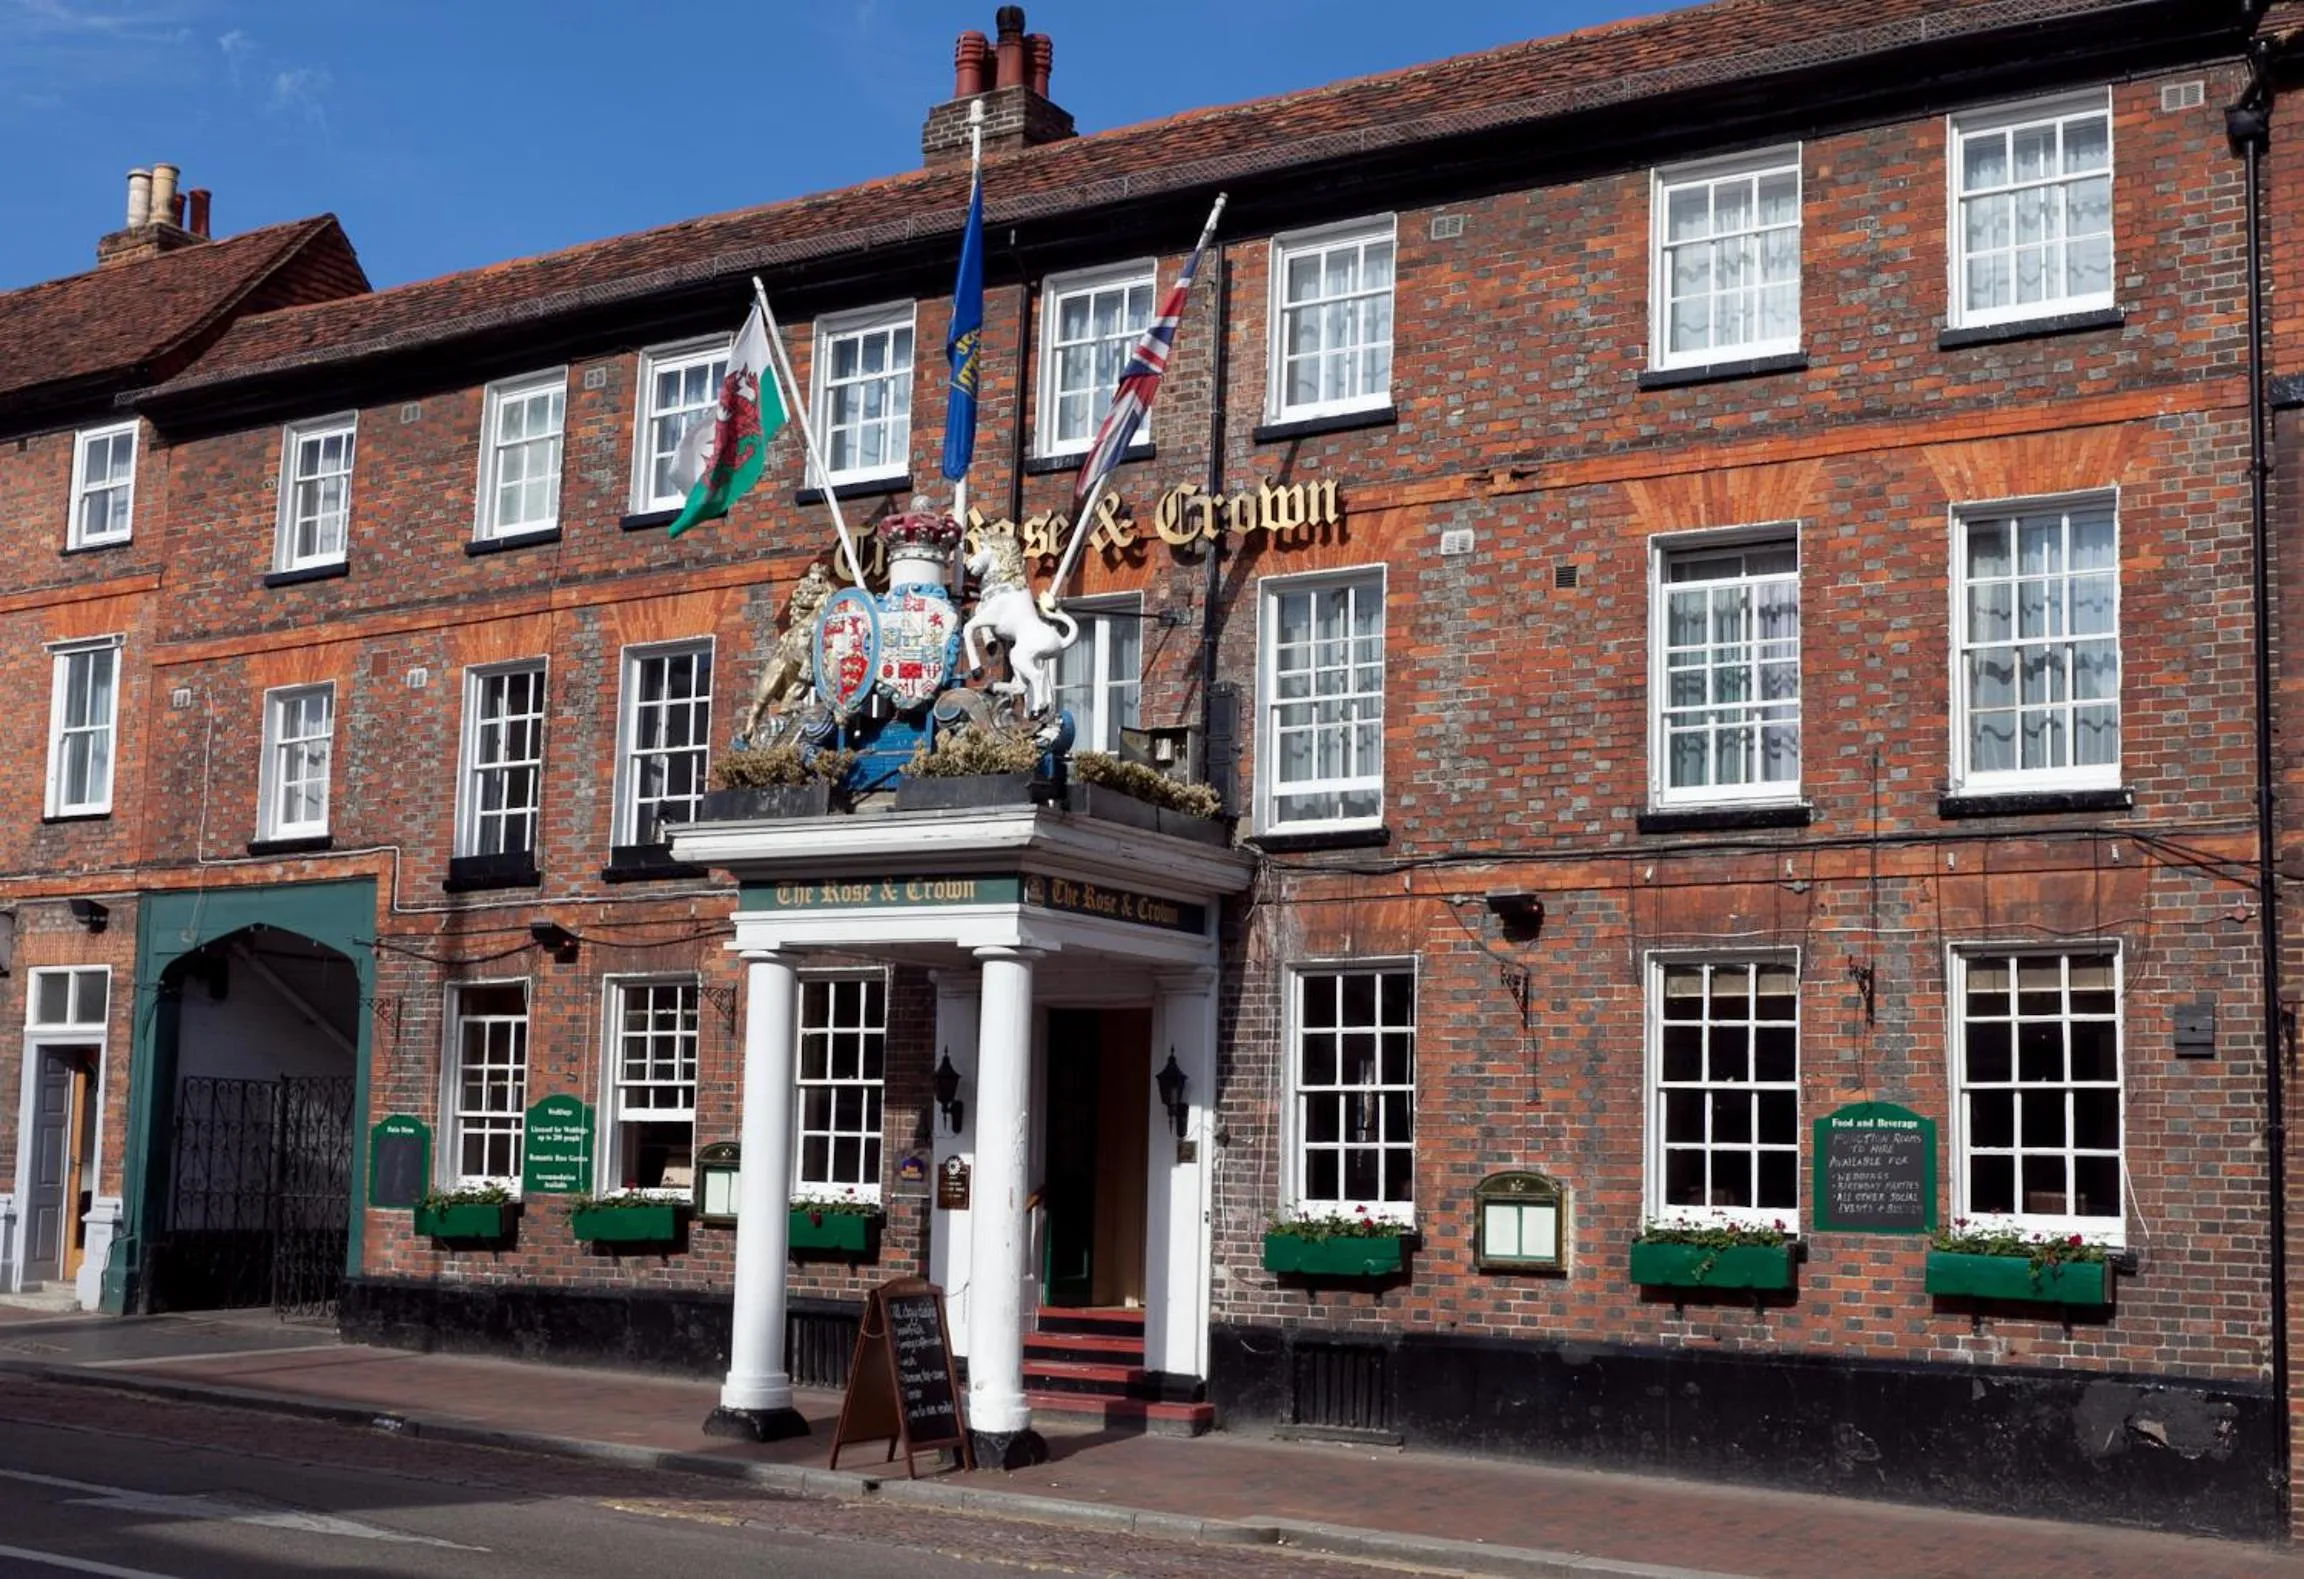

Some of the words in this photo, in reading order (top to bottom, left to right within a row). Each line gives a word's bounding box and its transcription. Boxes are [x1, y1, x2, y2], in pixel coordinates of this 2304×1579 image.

[1090, 492, 1137, 553] &
[1155, 474, 1340, 546] Crown
[776, 881, 812, 907] The
[821, 881, 872, 905] Rose
[880, 880, 898, 902] &
[905, 878, 976, 903] Crown
[1051, 877, 1078, 909] The
[1082, 883, 1116, 914] Rose
[1121, 892, 1133, 918] &
[1137, 897, 1179, 924] Crown
[1831, 1117, 1853, 1128] Food
[1856, 1117, 1874, 1128] and
[1877, 1118, 1918, 1129] Beverage
